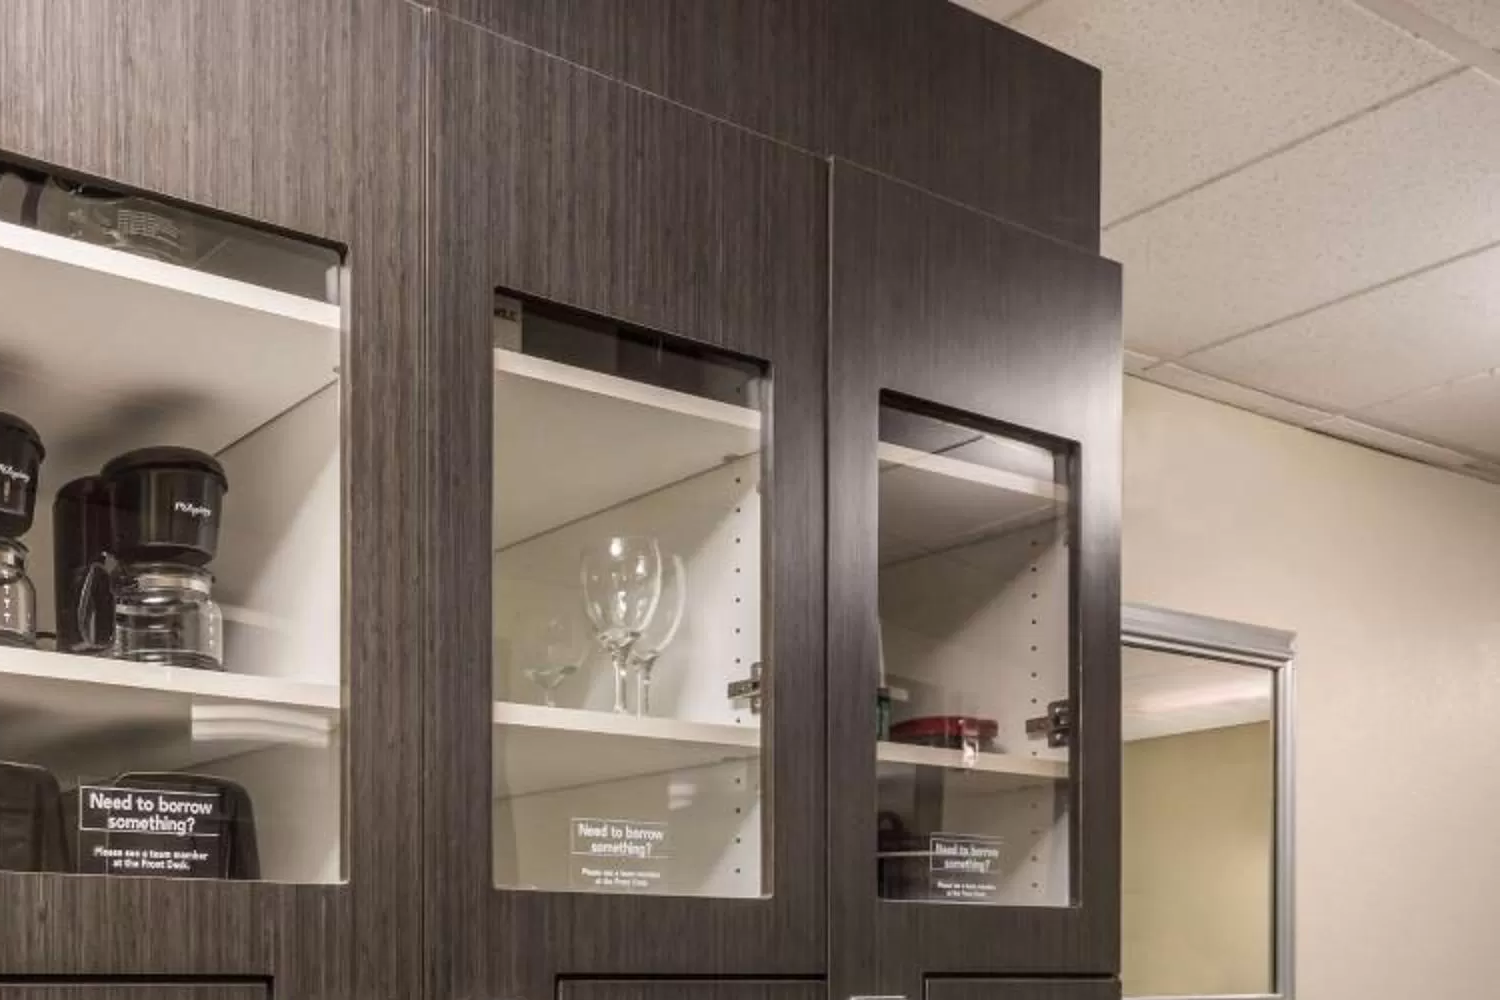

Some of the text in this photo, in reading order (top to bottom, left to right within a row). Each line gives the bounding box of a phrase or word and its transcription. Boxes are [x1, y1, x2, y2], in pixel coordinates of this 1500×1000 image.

[88, 793, 213, 815] Need to borrow
[107, 814, 196, 836] something?
[611, 825, 623, 838] to
